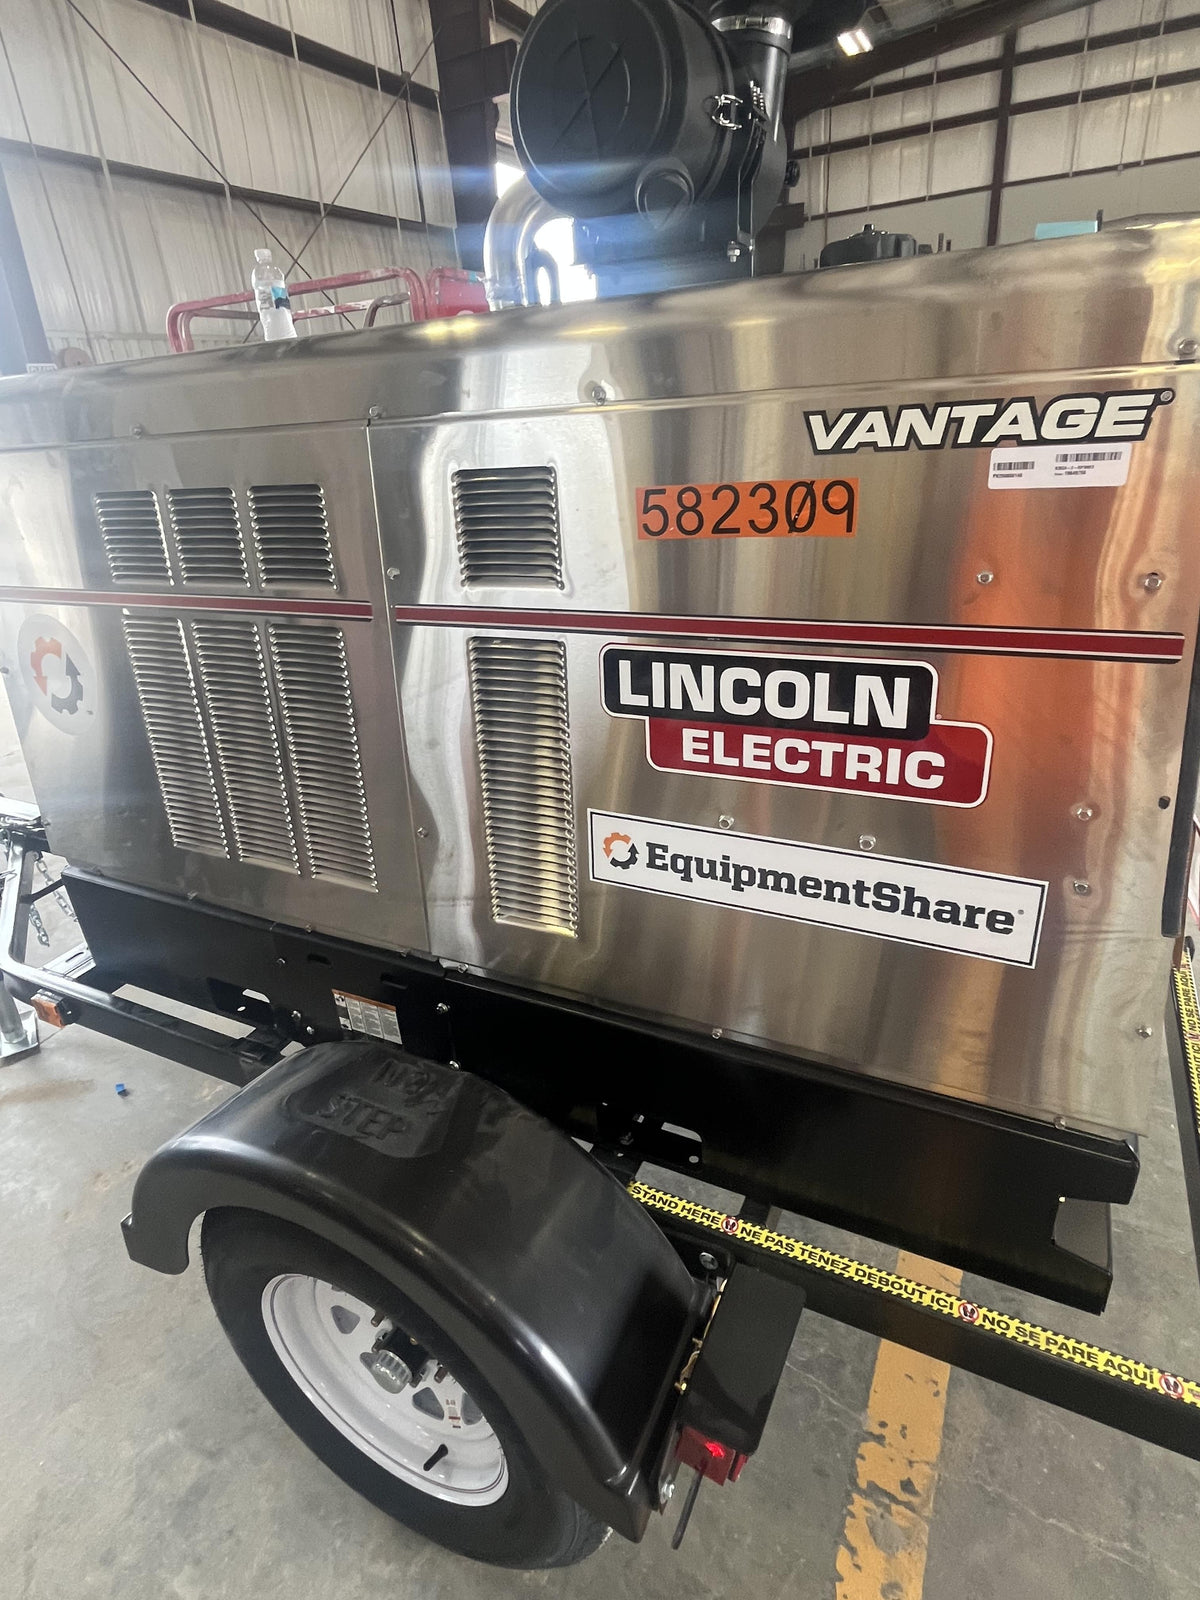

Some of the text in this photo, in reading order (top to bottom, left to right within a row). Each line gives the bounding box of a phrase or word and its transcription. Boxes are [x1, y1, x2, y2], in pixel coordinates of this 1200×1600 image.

[807, 392, 1157, 451] VANTAGE
[641, 480, 855, 537] 582309
[618, 659, 911, 730] LINCOLN
[681, 728, 946, 790] ELECTRIC
[645, 841, 1016, 937] EquipmentShare
[1183, 988, 1193, 1007] PARE
[317, 1093, 407, 1141] STEP
[631, 1185, 721, 1226] STAND HERE
[740, 1227, 955, 1311] NE PAS TENEZ DEBOUT ICI
[982, 1313, 1011, 1331] NO
[1015, 1326, 1041, 1343] SE
[1045, 1336, 1099, 1363] PARE
